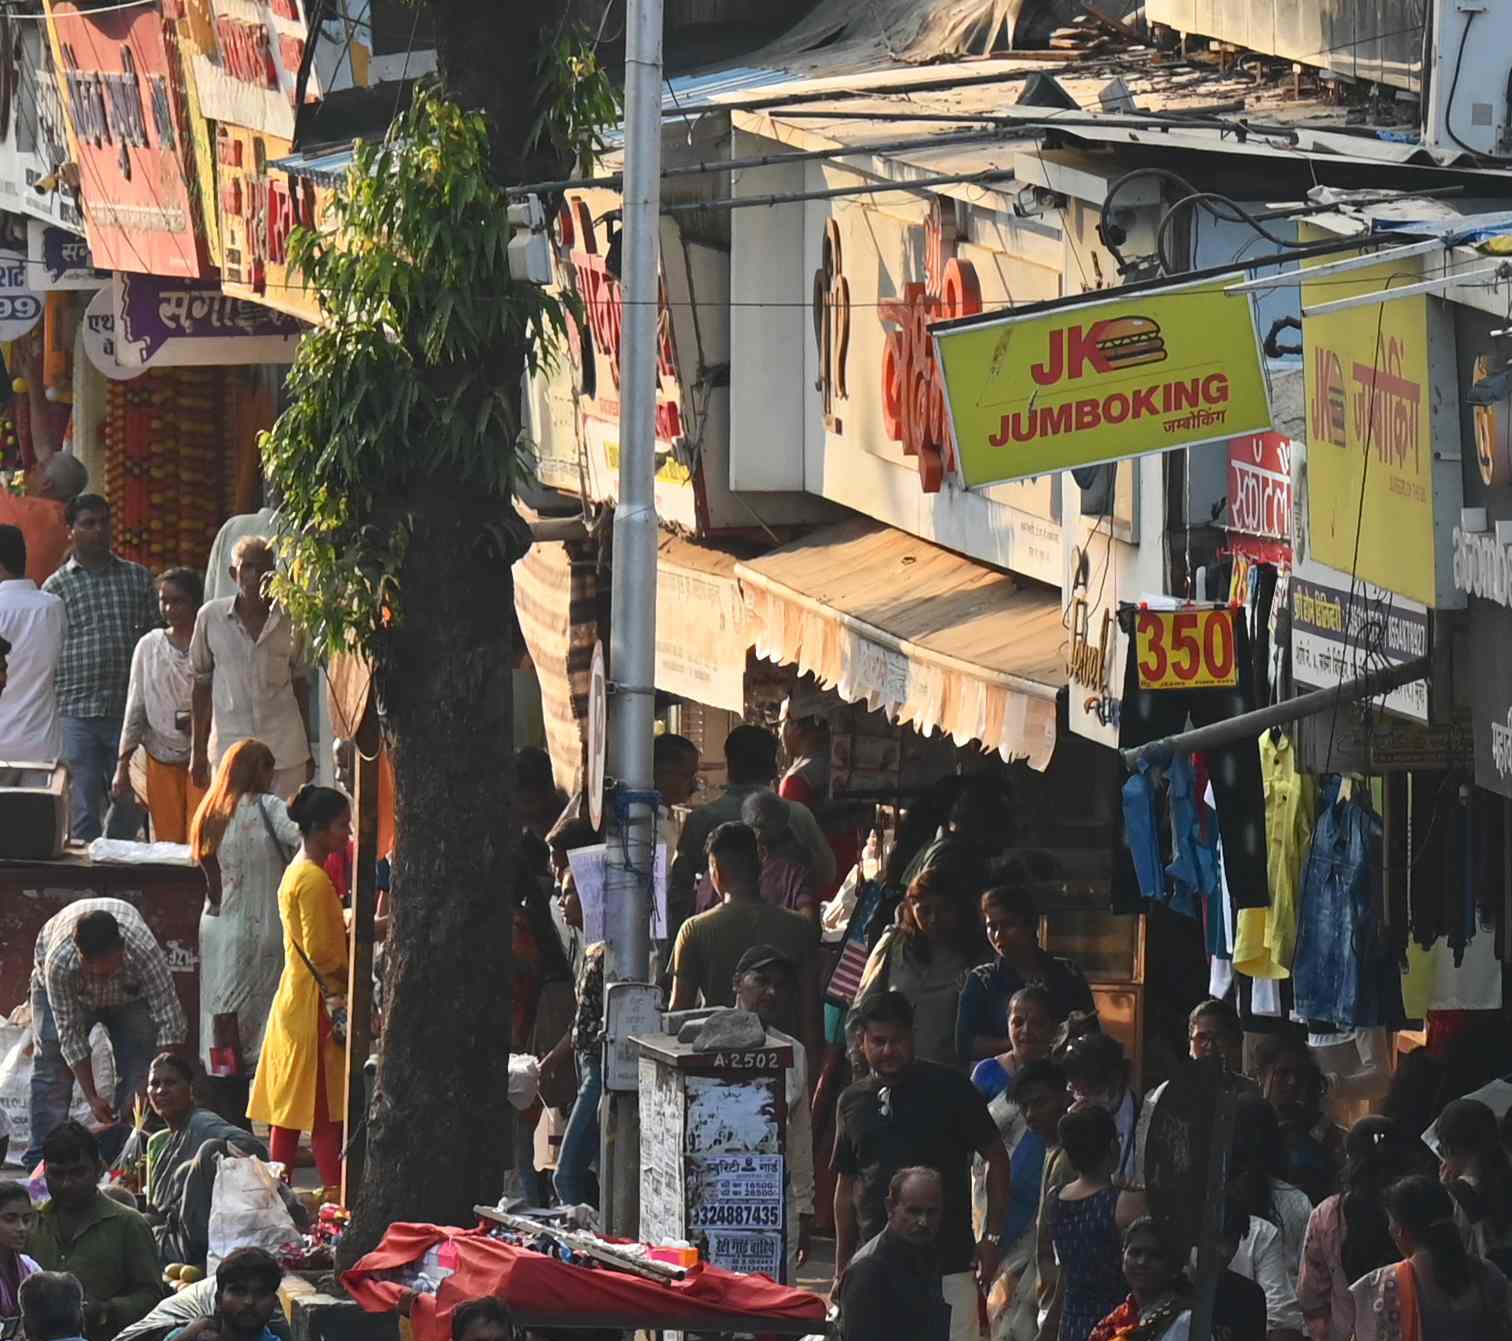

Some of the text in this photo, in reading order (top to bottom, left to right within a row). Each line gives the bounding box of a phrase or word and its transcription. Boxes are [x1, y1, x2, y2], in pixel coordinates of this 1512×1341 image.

[1031, 320, 1113, 385] JK
[989, 373, 1229, 448] JUMBOKING
[1163, 406, 1227, 433] जम्बोकिंग
[1138, 612, 1233, 683] 350
